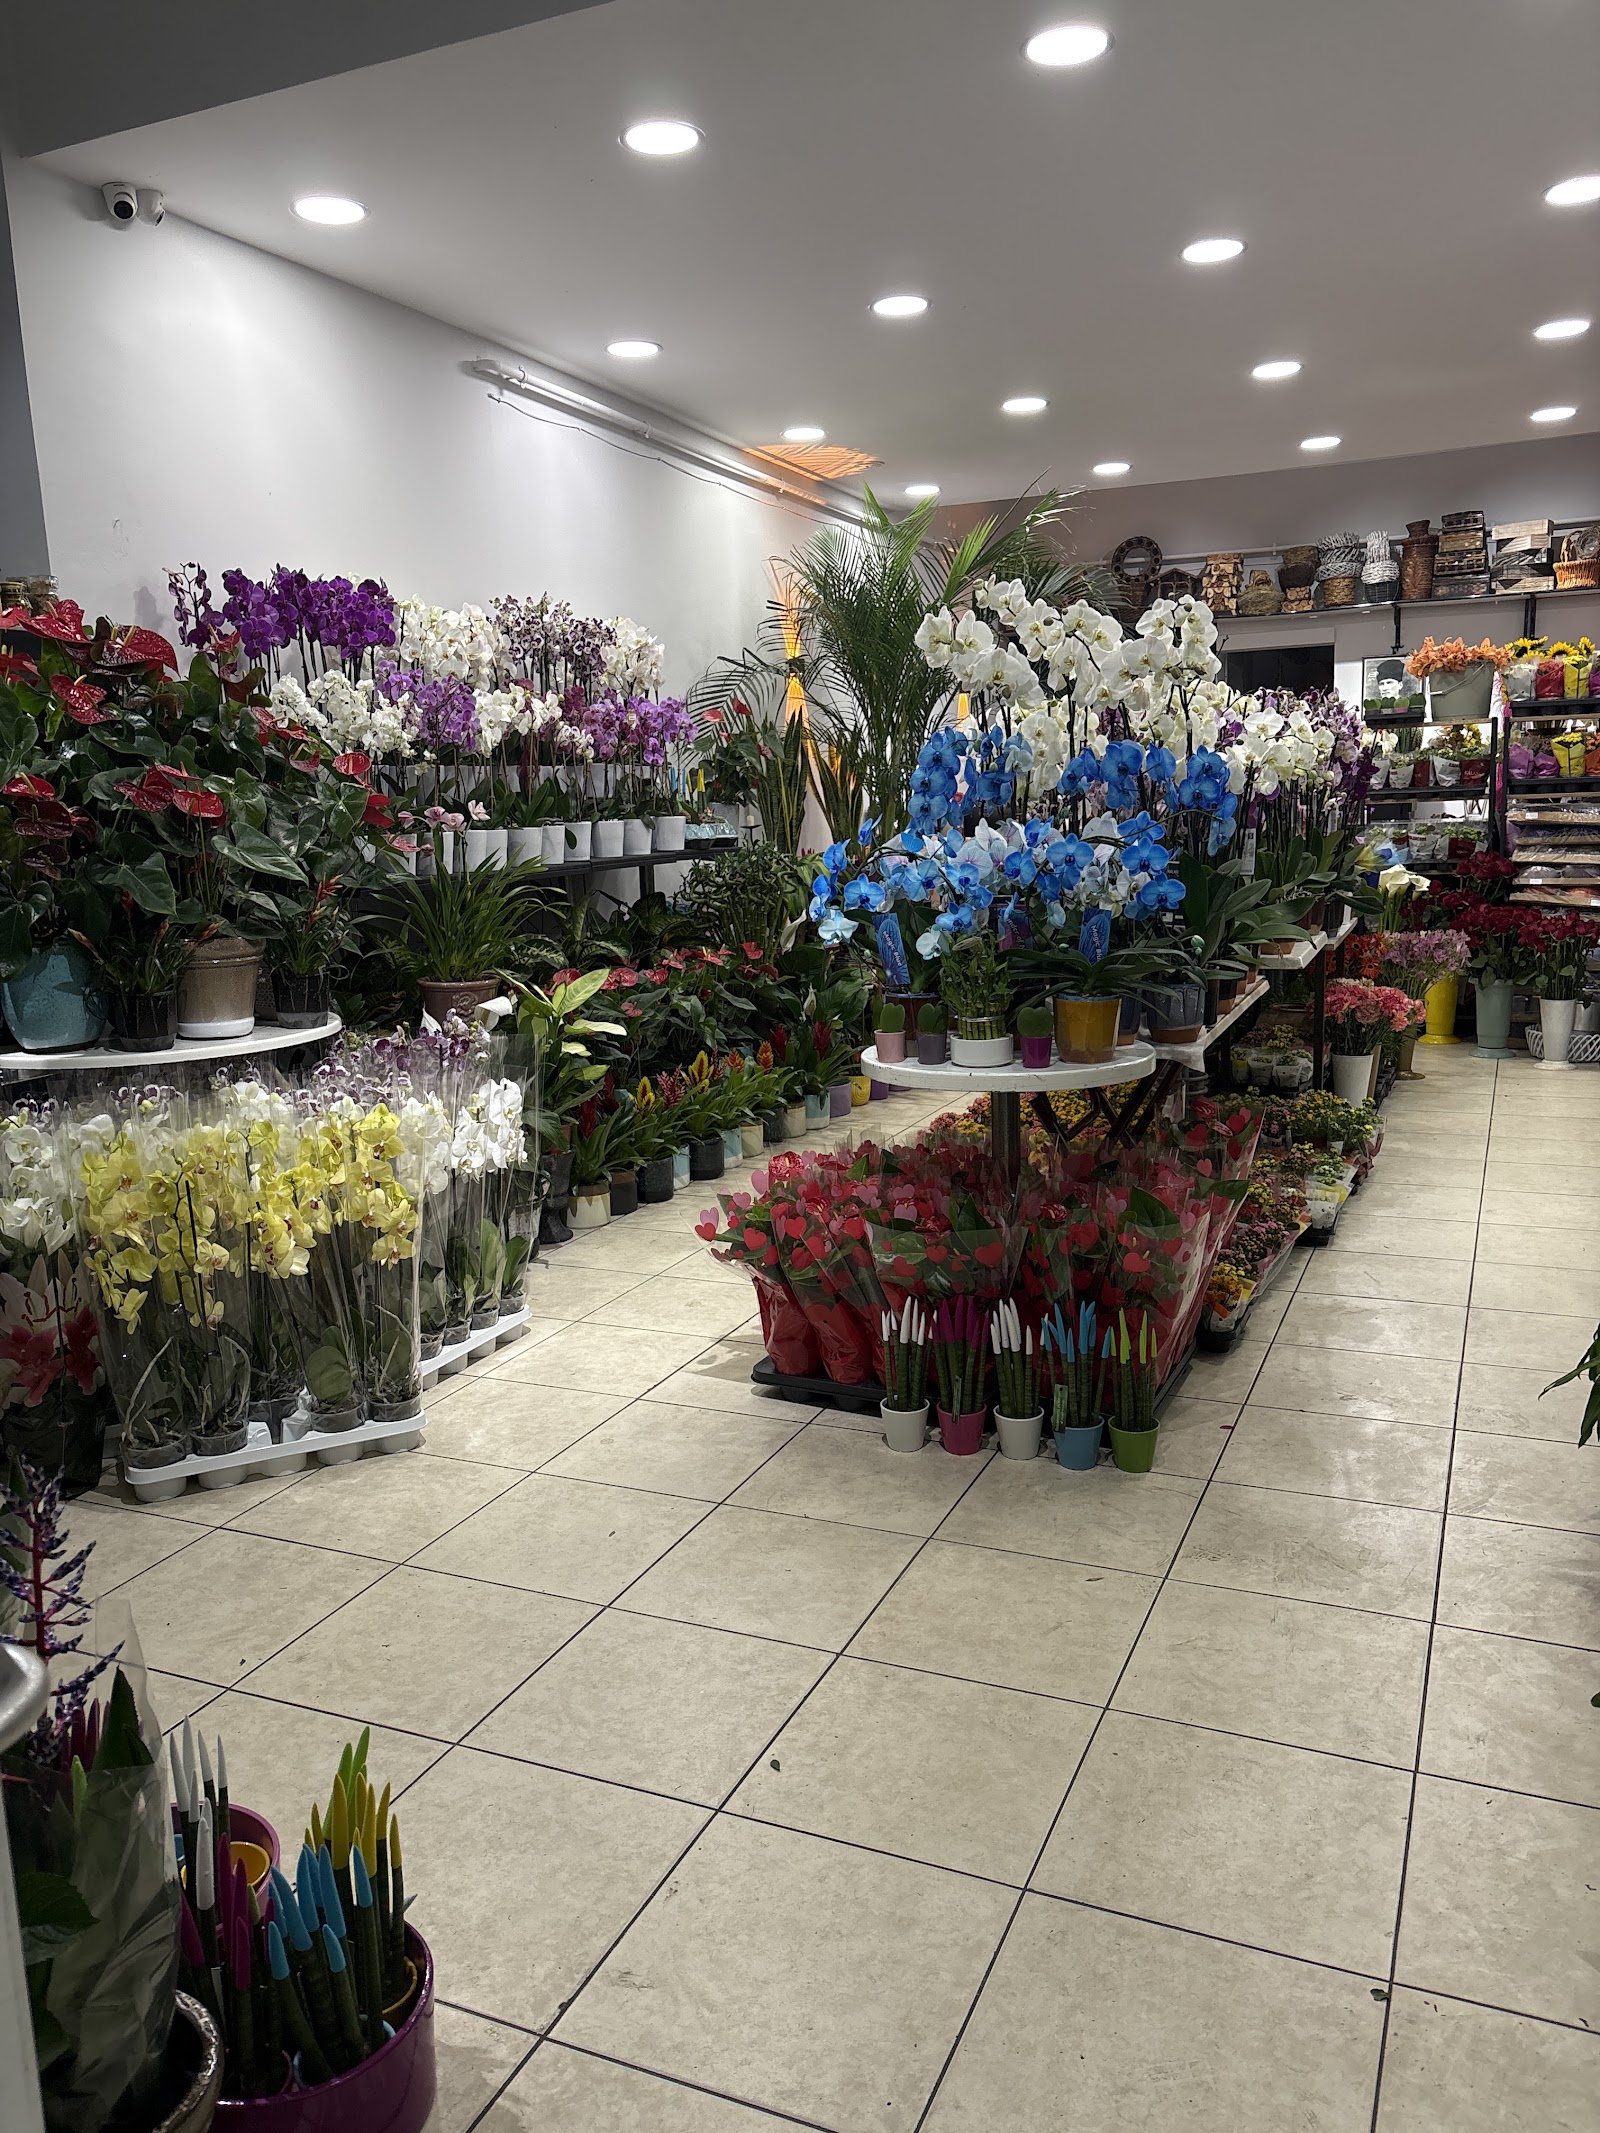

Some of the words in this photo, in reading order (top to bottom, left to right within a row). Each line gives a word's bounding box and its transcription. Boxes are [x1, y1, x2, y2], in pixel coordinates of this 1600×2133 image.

[1007, 918, 1020, 935] nder
[1091, 925, 1100, 948] Magic
[882, 930, 896, 951] Magic
[893, 951, 902, 967] Blue
